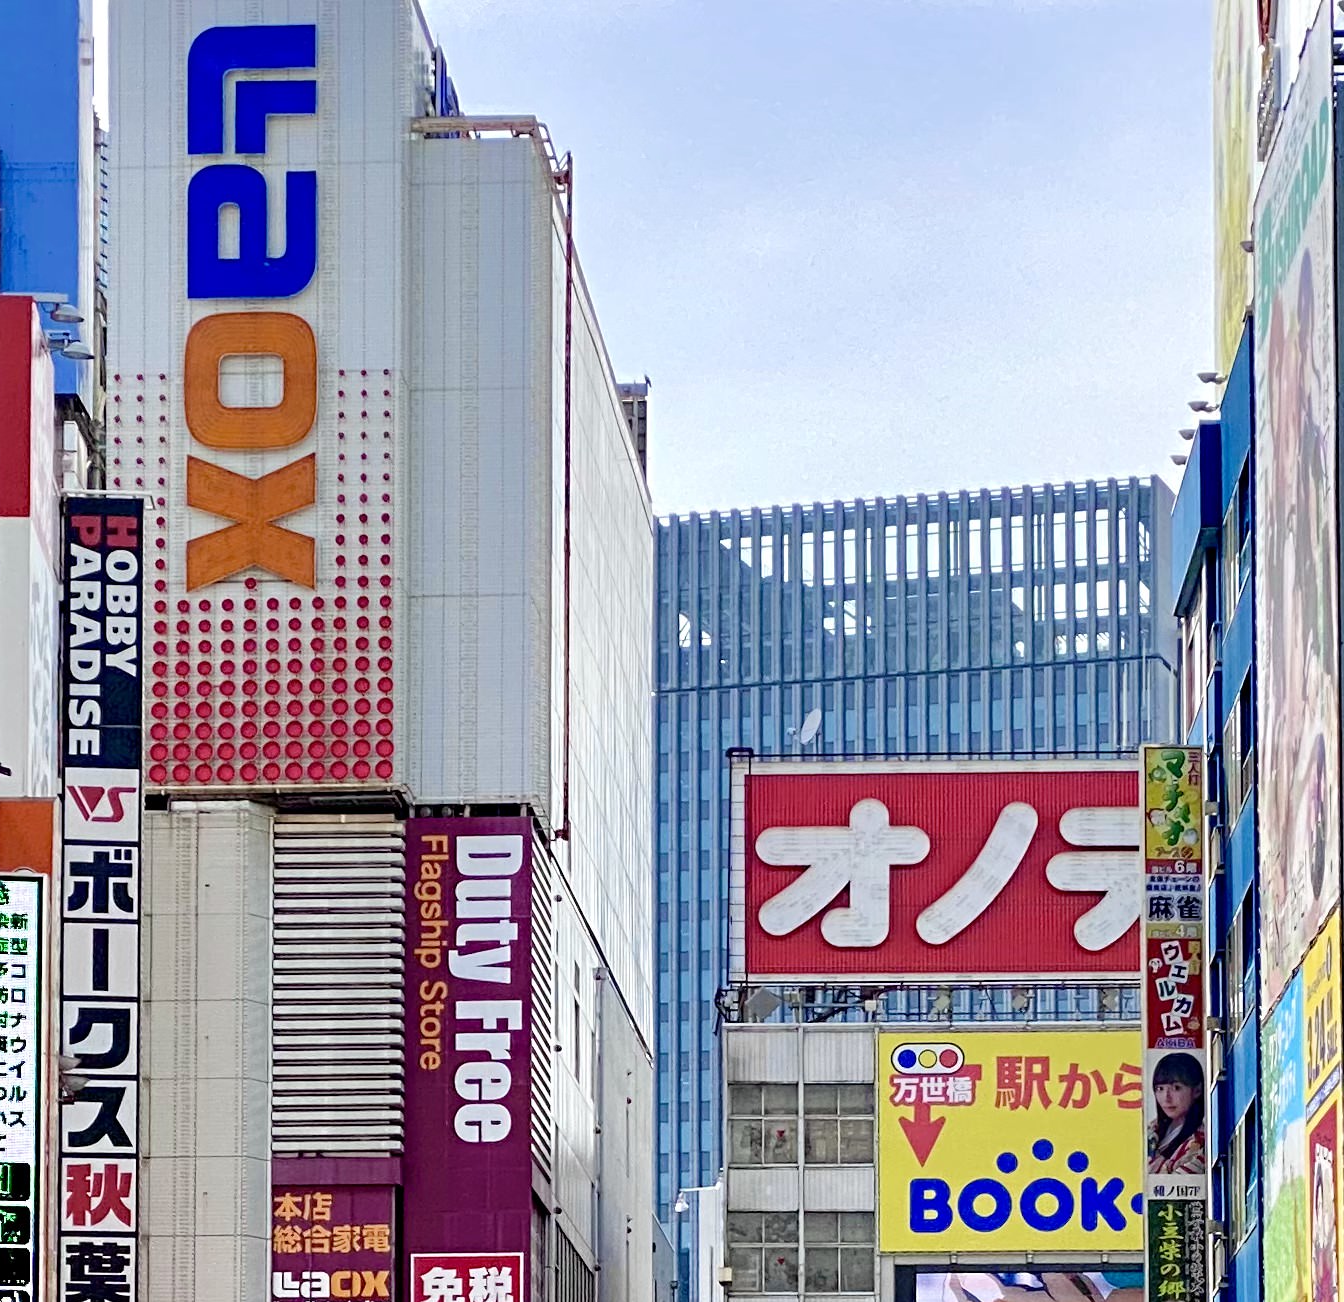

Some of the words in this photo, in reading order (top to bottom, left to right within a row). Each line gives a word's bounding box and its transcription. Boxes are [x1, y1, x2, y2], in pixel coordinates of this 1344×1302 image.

[68, 515, 102, 756] PARADISE
[105, 515, 138, 678] HOBBY
[414, 834, 450, 970] Flagship
[449, 834, 524, 985] Duty
[1149, 895, 1202, 919] 麻雀
[8, 912, 29, 1128] 新型コロナウイルス
[419, 980, 449, 1072] Store
[454, 999, 523, 1144] Free
[894, 1077, 974, 1104] 万世橋
[272, 1223, 391, 1254] 総合家電
[273, 1191, 334, 1223] 本店
